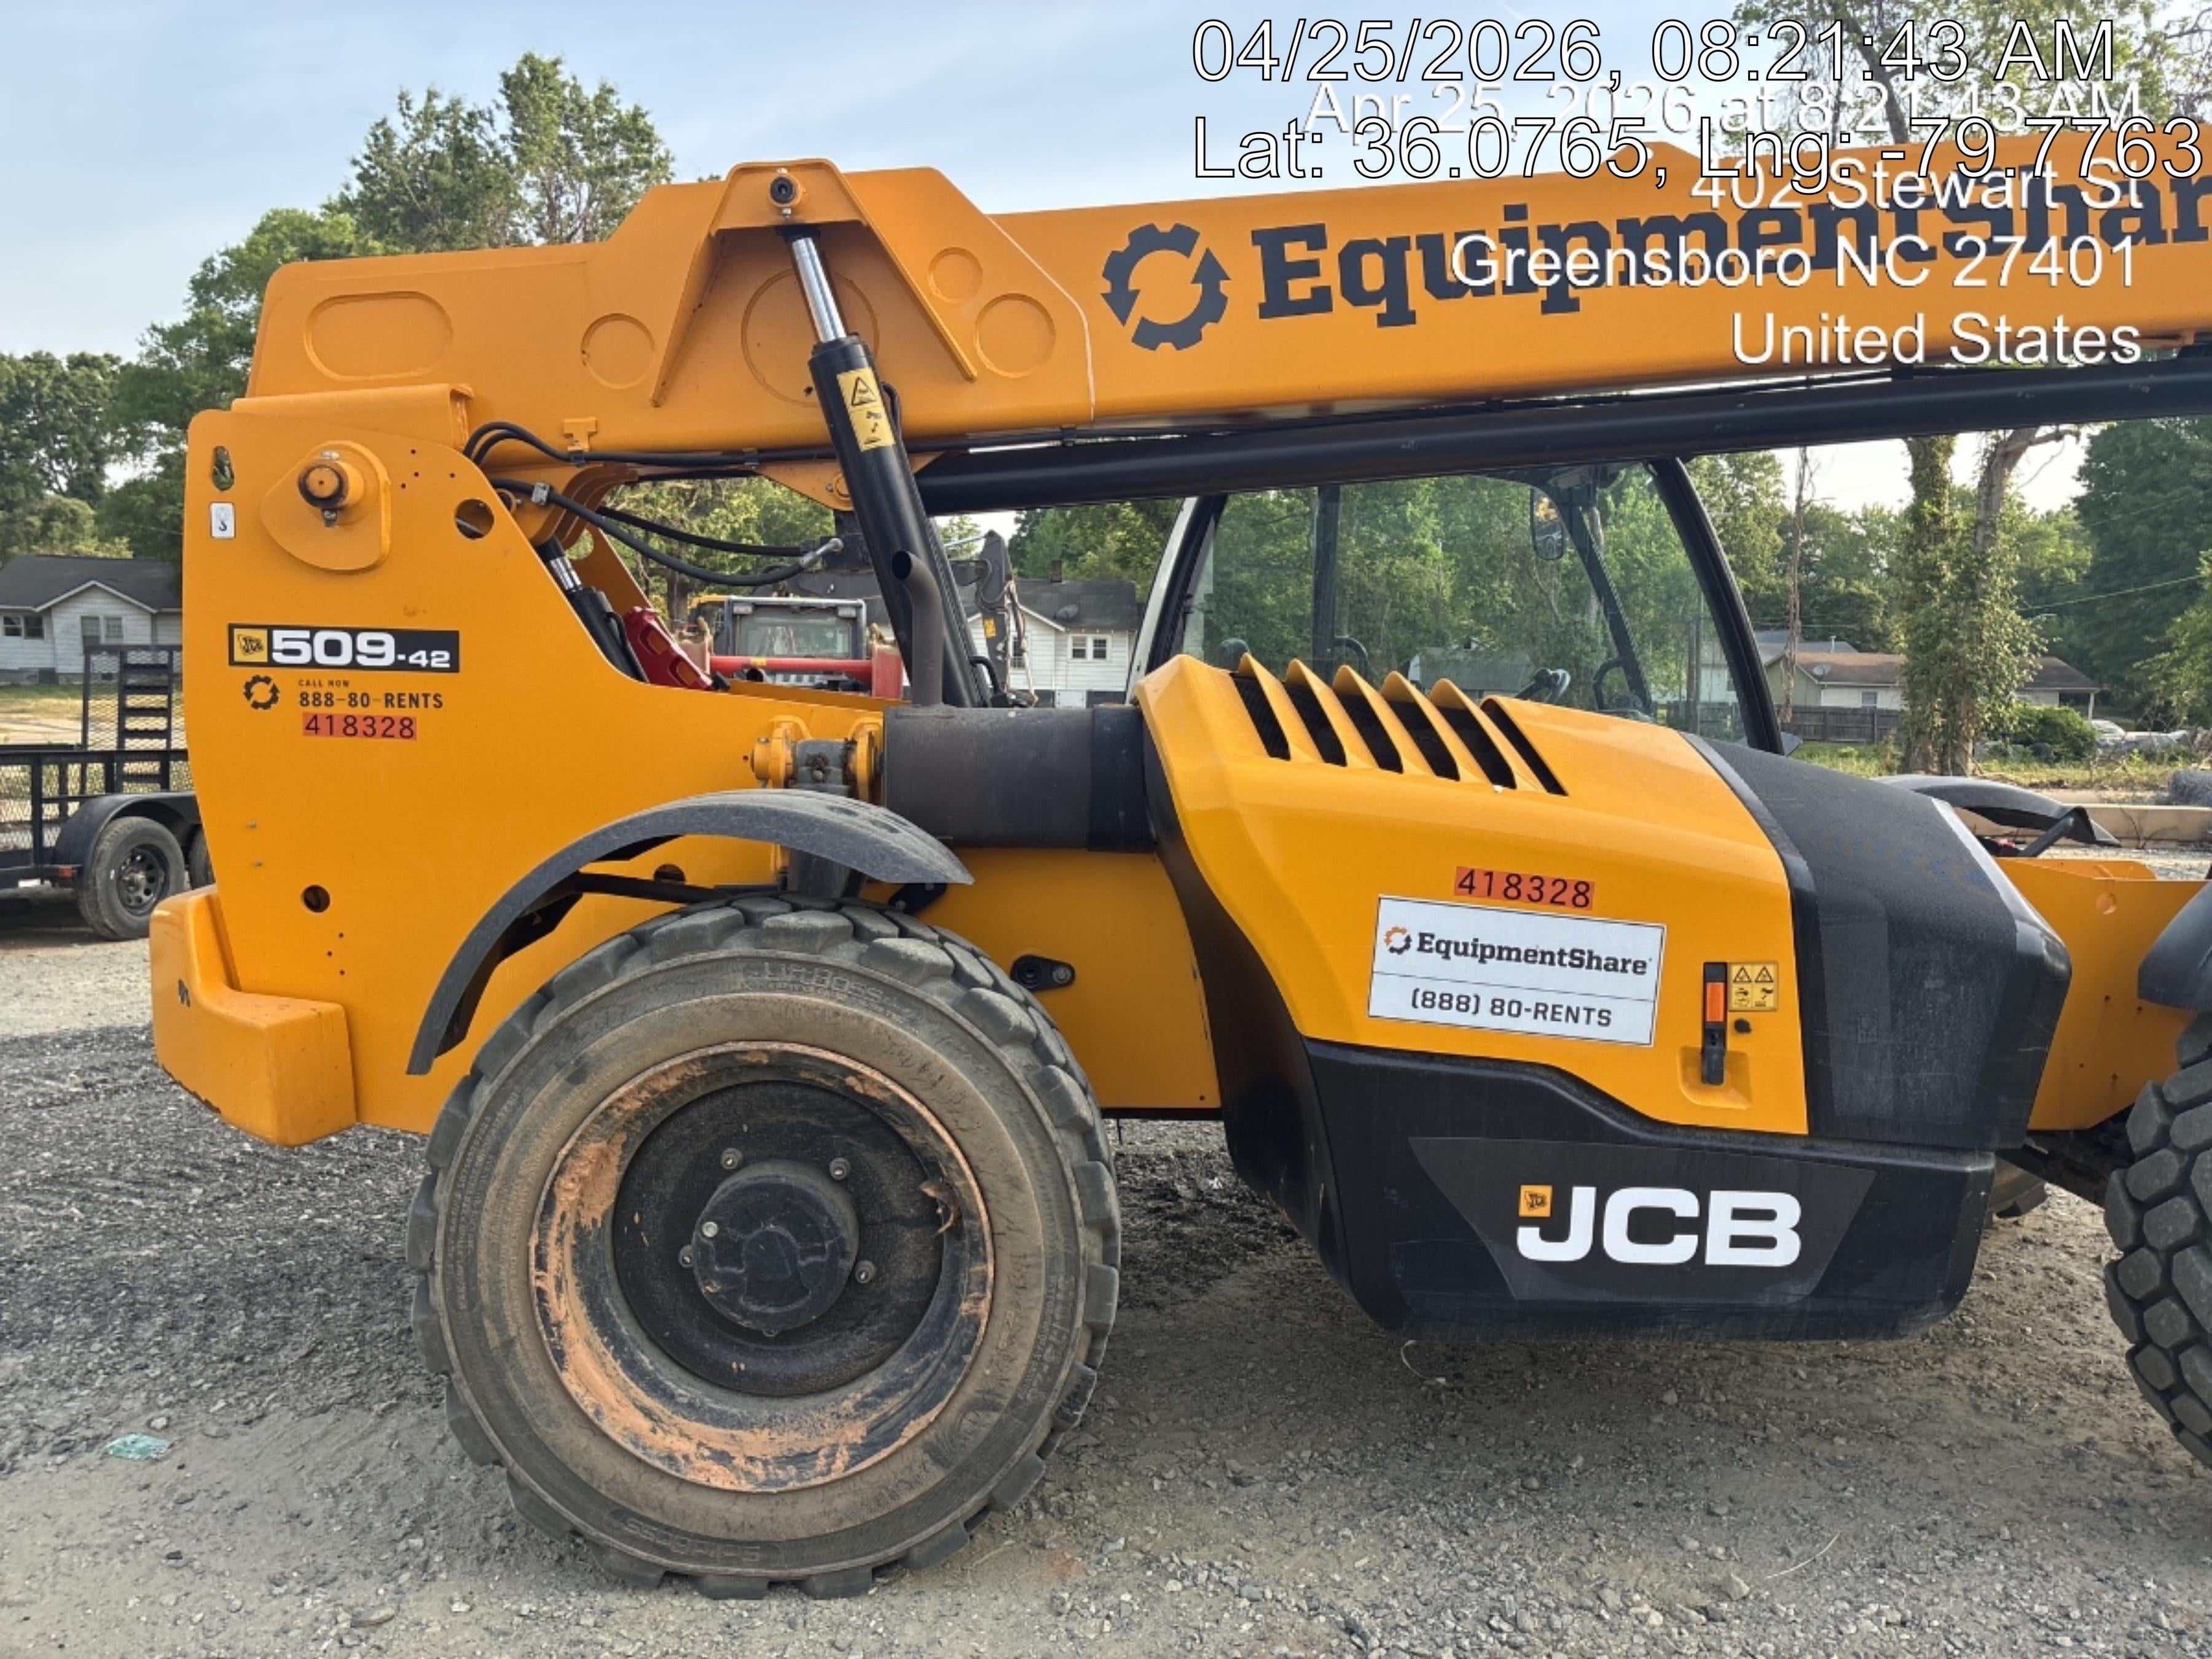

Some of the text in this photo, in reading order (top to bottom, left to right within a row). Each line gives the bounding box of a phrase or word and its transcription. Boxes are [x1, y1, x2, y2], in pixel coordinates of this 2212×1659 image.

[272, 629, 451, 669] 509-42
[298, 679, 350, 688] CALL NOW
[304, 714, 415, 740] 418328
[1457, 868, 1591, 909] 418328
[1416, 931, 1648, 976] EquipmentShare
[1411, 987, 1613, 1027] (888) 80-RENTS
[1516, 1185, 1802, 1267] JCB
